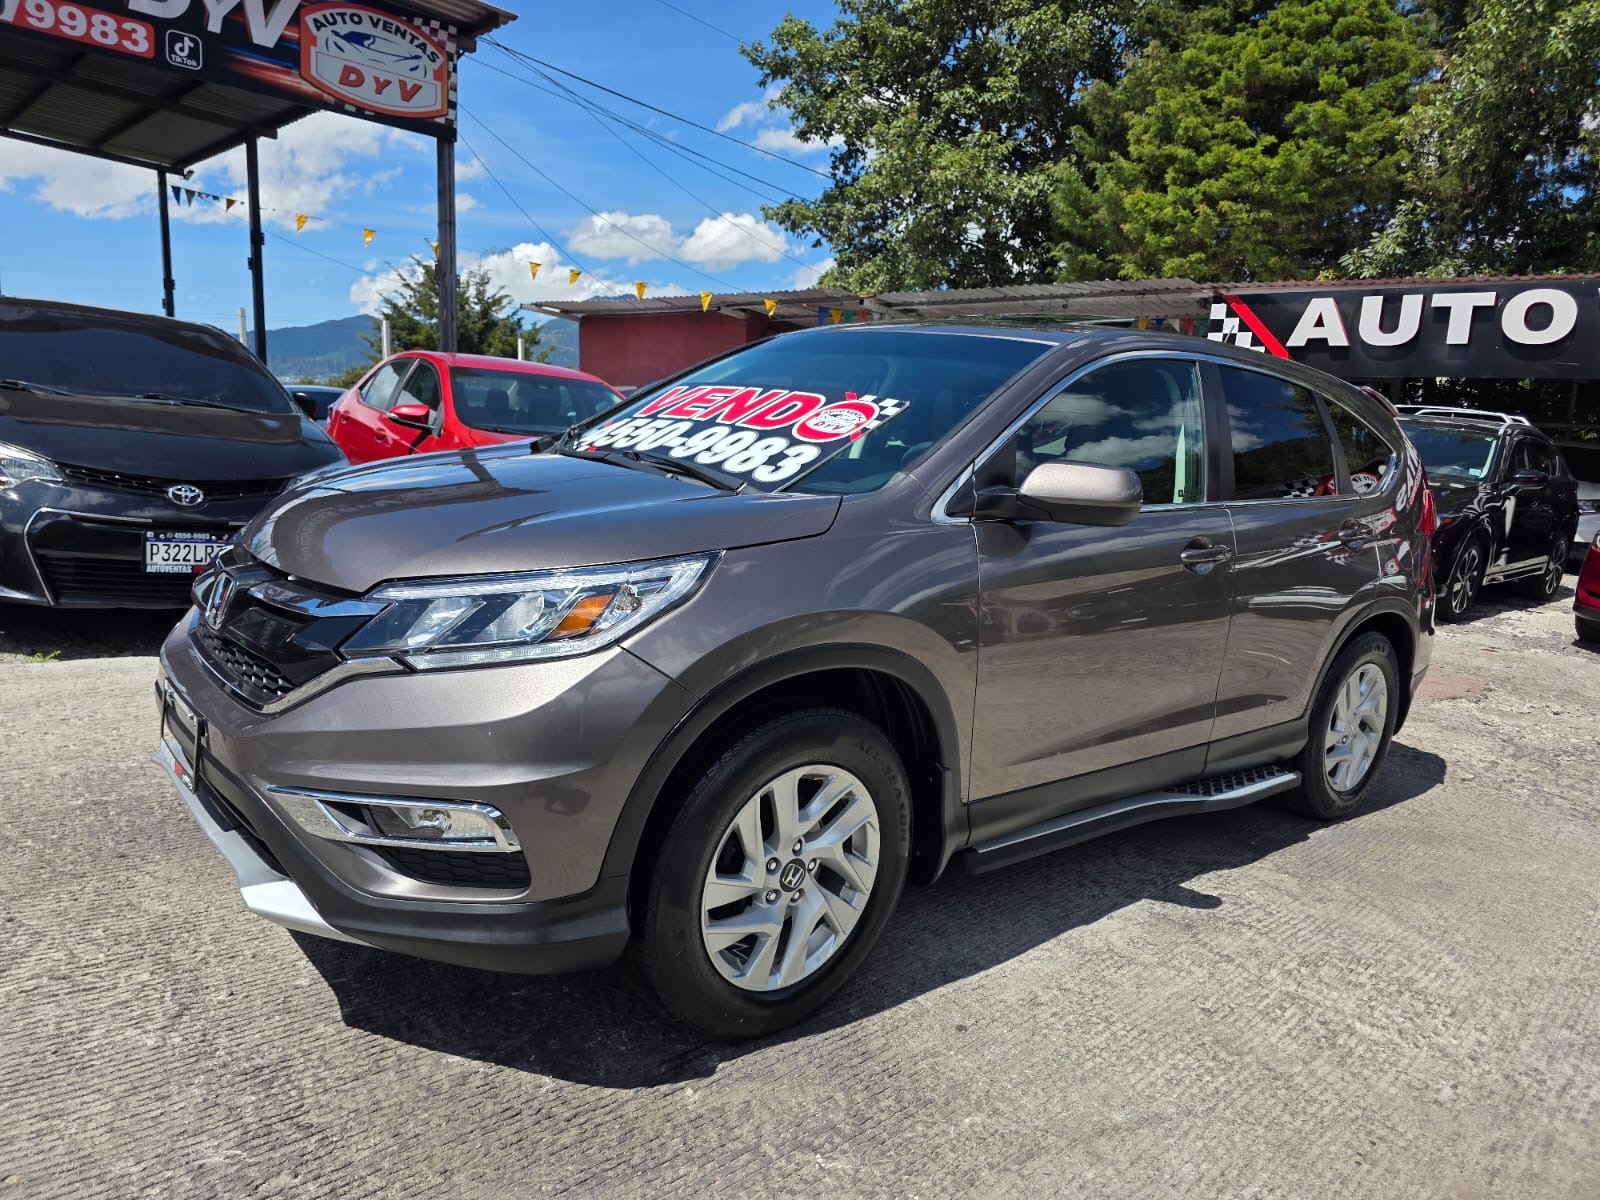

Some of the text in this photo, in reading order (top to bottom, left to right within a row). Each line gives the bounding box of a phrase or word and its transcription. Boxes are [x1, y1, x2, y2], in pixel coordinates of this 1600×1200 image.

[25, 0, 149, 53] 9983
[312, 12, 440, 63] AUTO VENTAS
[338, 64, 422, 102] DYV
[1286, 288, 1579, 347] AUTO
[146, 565, 192, 573] AUTOVENTAS
